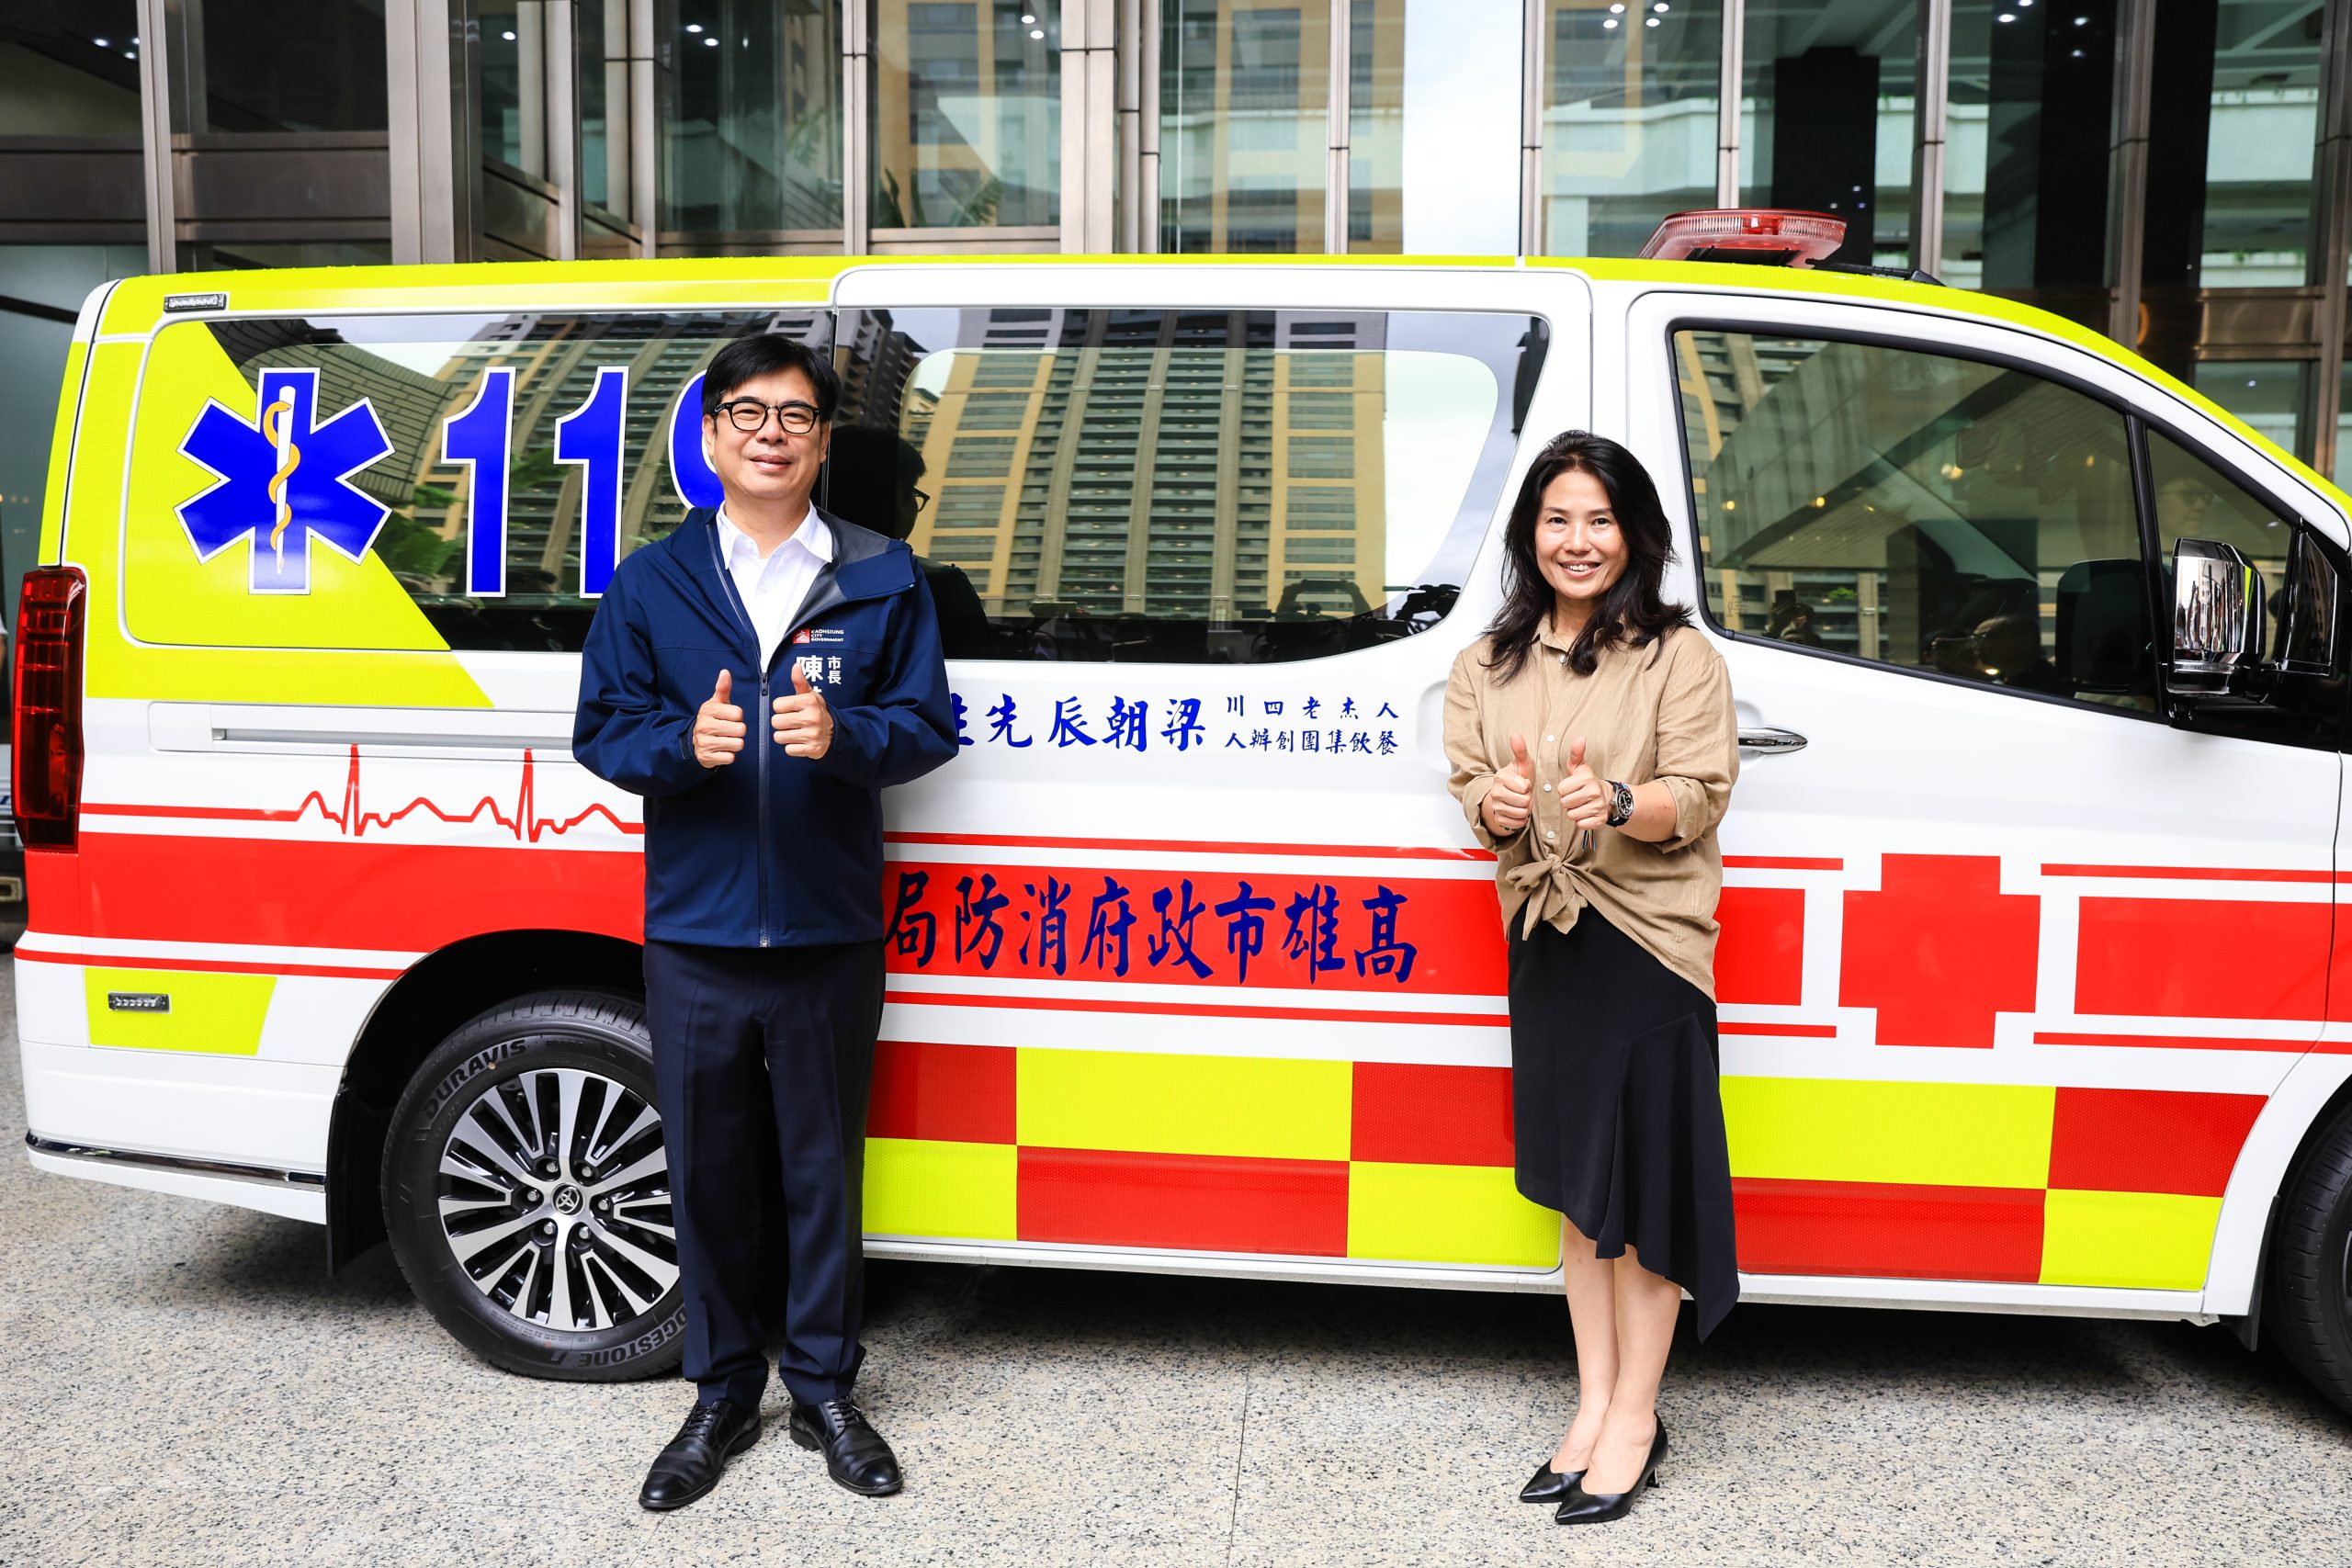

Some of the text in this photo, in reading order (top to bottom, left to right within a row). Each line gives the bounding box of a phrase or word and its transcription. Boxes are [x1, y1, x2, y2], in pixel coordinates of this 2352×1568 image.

[796, 655, 823, 694] 陳
[827, 656, 842, 684] 市長
[423, 1039, 526, 1119] DURAVIS
[578, 1307, 688, 1368] DGESTONE
